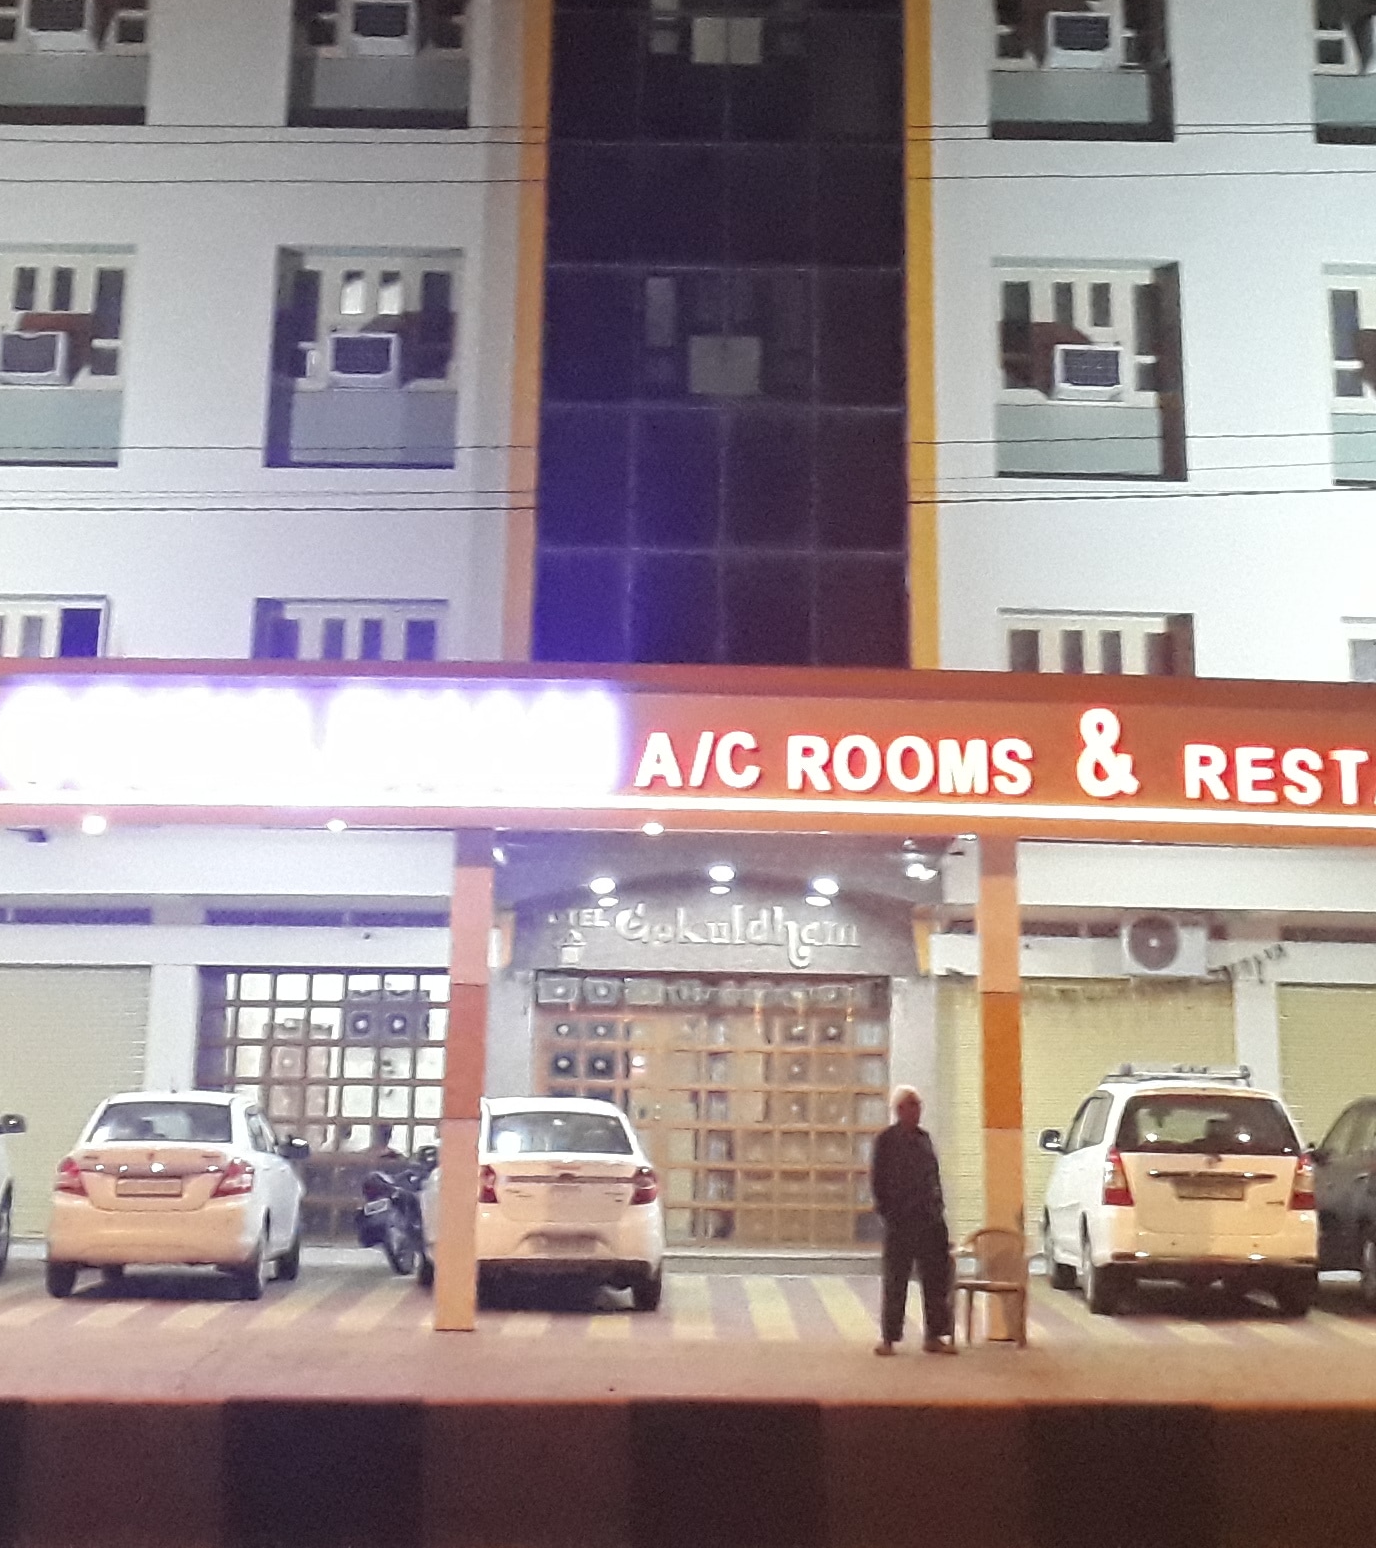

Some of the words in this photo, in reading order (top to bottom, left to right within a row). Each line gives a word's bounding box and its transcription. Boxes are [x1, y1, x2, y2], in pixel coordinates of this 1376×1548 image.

[633, 729, 761, 790] A/C
[785, 733, 1033, 798] ROOMS
[1076, 706, 1141, 799] &
